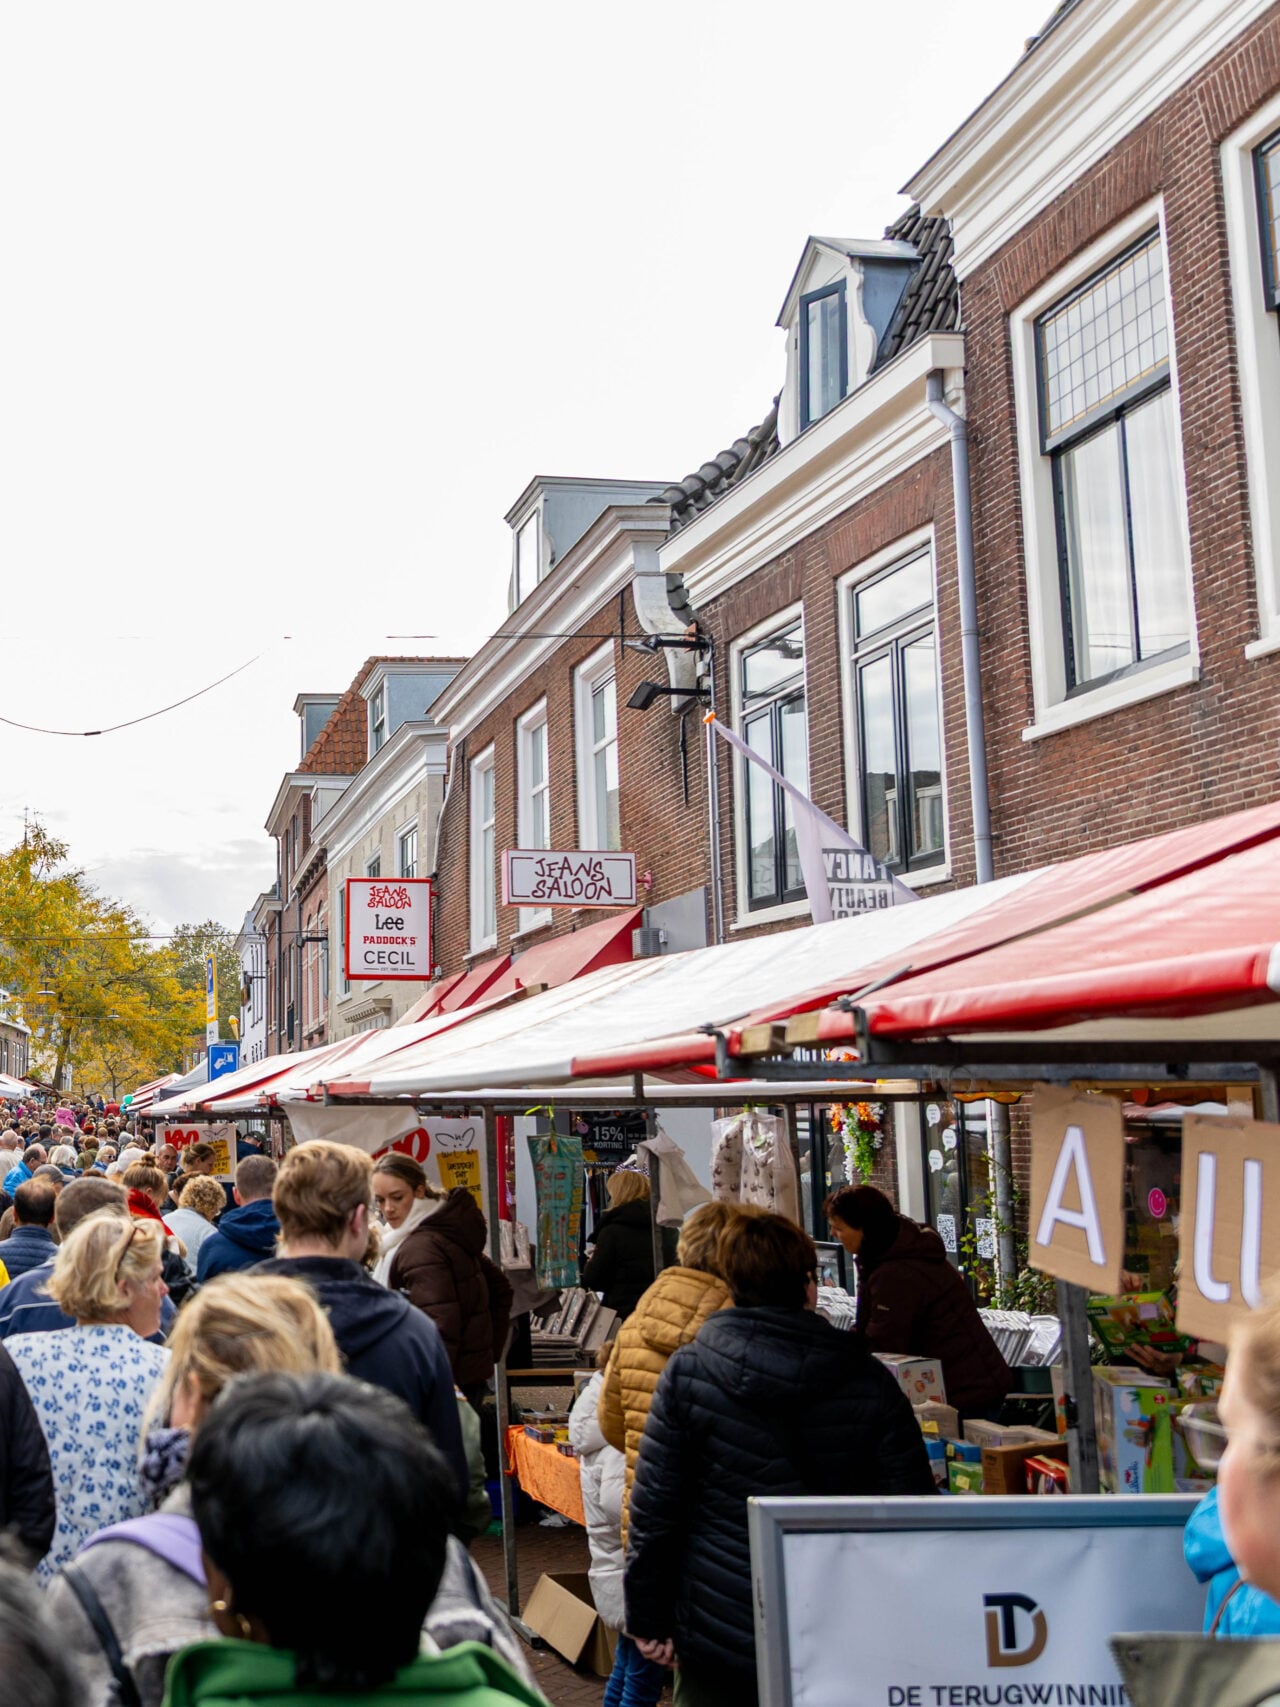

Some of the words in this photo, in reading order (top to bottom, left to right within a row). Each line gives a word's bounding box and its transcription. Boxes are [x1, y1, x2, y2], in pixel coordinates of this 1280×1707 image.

[534, 856, 605, 881] JEANS
[369, 885, 408, 899] JEANS
[531, 877, 612, 900] SALOON
[367, 896, 412, 909] SALOON
[375, 914, 404, 930] Lee
[363, 936, 416, 945] PADDOCK'S
[364, 950, 416, 965] CECIL
[592, 1126, 624, 1142] 15%
[593, 1141, 623, 1149] KORTING
[1035, 1125, 1108, 1267] A
[888, 1686, 922, 1707] DE
